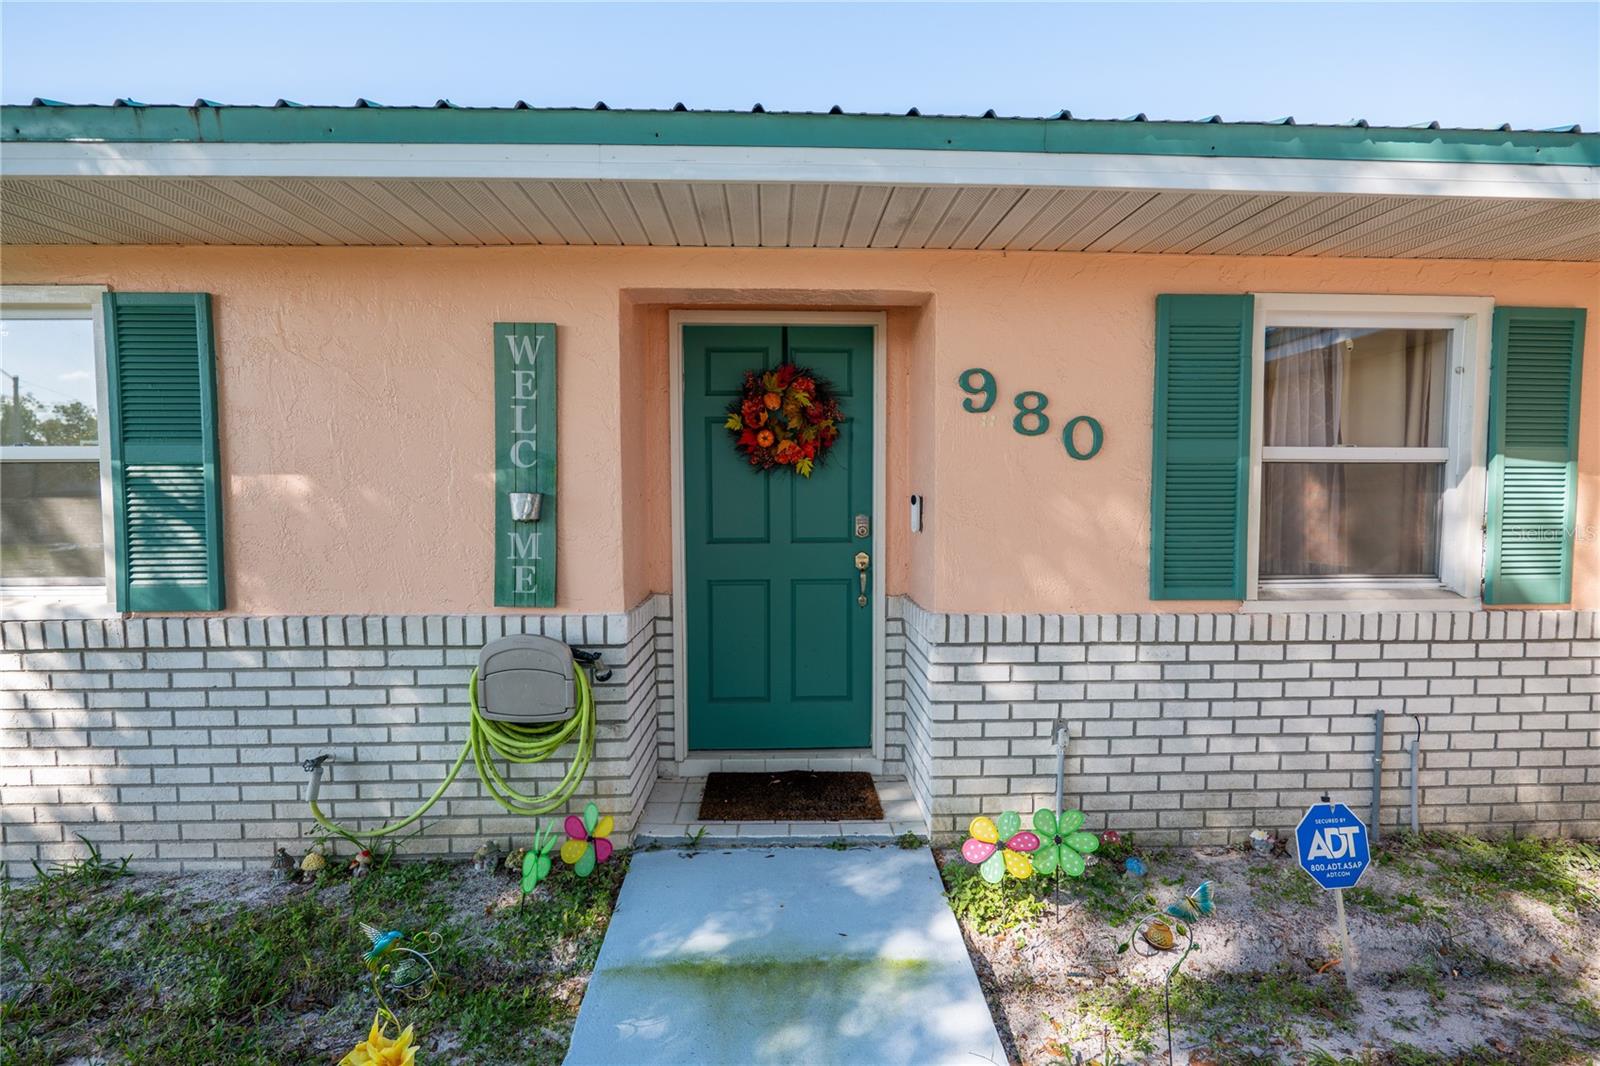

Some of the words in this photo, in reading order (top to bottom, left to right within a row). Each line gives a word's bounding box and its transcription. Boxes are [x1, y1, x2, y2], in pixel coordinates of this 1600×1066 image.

[958, 368, 1104, 461] 980
[505, 335, 545, 593] WELCME
[1307, 826, 1360, 860] ADT
[1310, 861, 1362, 872] 800.ADT.ASAP
